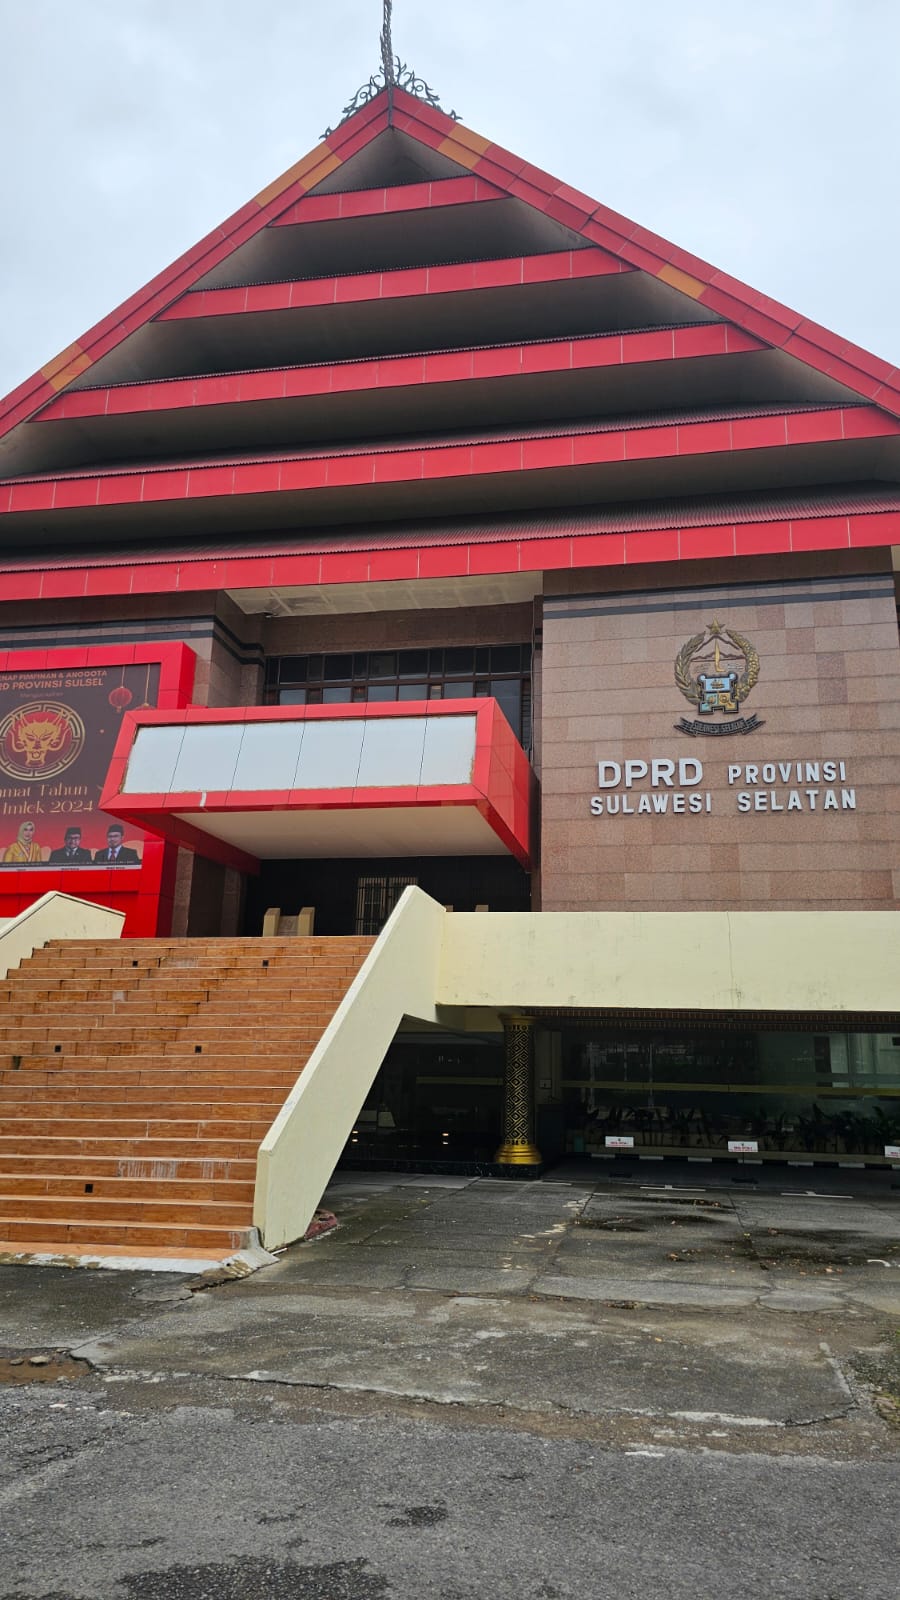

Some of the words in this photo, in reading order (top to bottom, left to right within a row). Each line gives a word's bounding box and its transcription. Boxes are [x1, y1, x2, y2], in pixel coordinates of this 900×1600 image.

[13, 680, 62, 690] PROVINSI
[65, 678, 104, 688] SULSEL
[598, 758, 703, 788] DPRD
[728, 761, 847, 785] PROVINSI
[40, 782, 88, 797] Tahun
[3, 800, 45, 815] Imlek
[49, 800, 94, 813] 2024
[590, 793, 712, 816] SULAWESI
[737, 789, 857, 812] SELATAN
